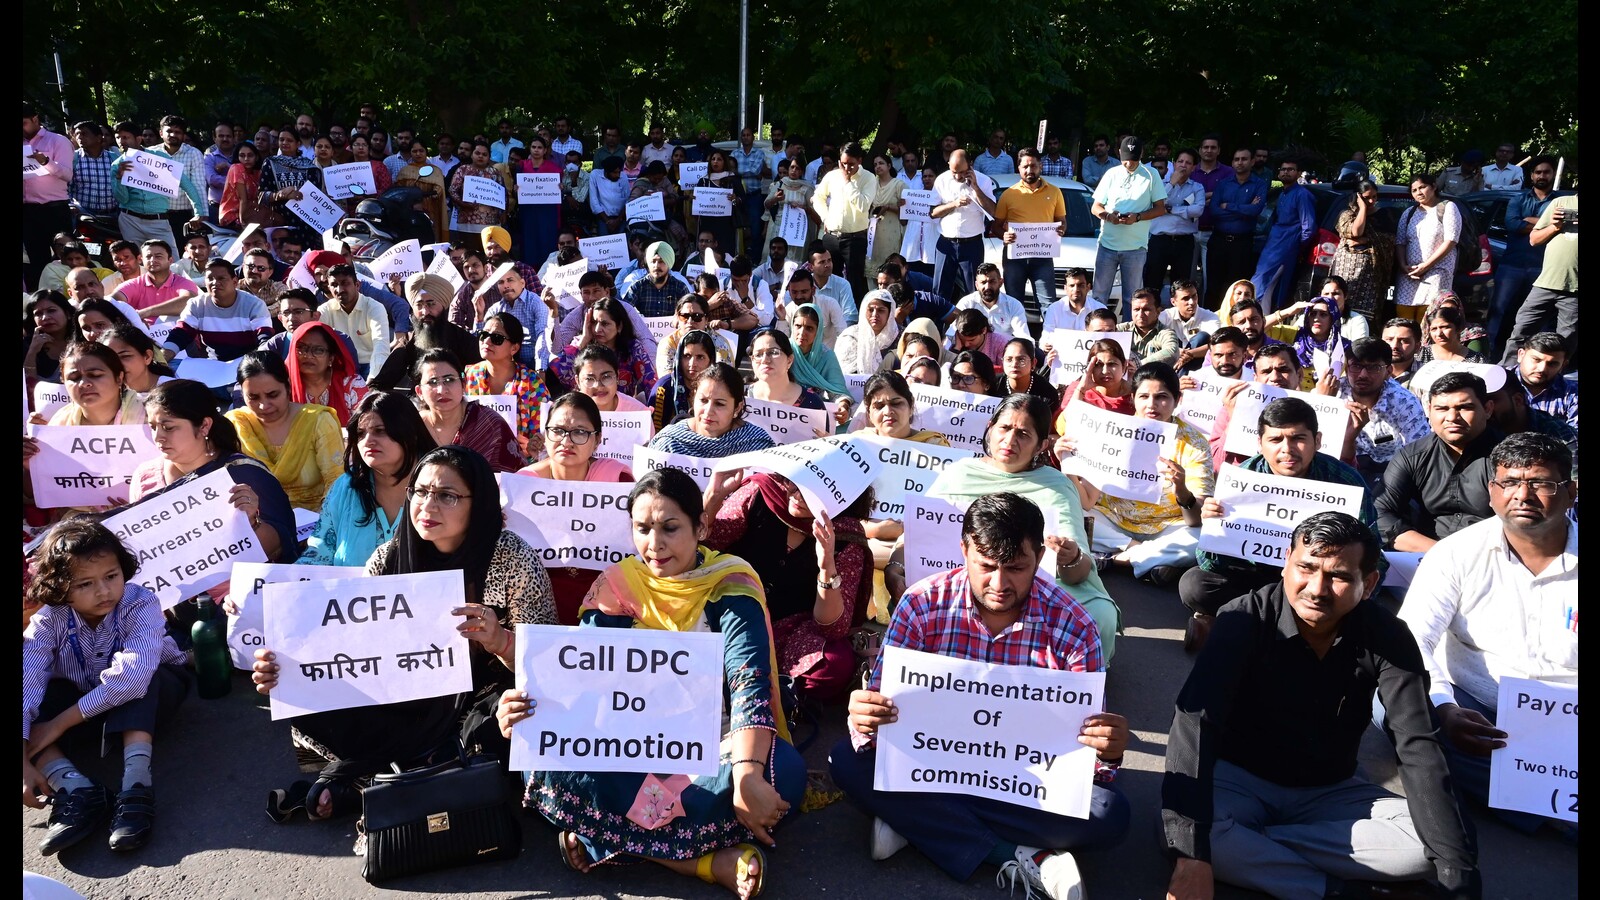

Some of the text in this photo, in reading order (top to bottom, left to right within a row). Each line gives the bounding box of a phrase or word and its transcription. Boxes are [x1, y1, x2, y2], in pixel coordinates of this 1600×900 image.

[136, 155, 174, 172] Call DPC
[327, 165, 370, 175] Implementation
[149, 171, 159, 179] Do
[127, 175, 174, 195] Promotion
[475, 185, 493, 193] Arrears
[309, 190, 336, 215] Call DPC
[480, 195, 504, 205] Teachers
[293, 202, 326, 233] Promotion
[312, 206, 320, 215] Do
[394, 244, 412, 254] DPC
[591, 237, 623, 246] commission
[555, 271, 566, 280] Pay
[1074, 338, 1095, 351] AC
[1200, 381, 1222, 396] Pay
[1247, 389, 1269, 403] Pay
[746, 404, 809, 424] Call DPC
[951, 416, 965, 427] Of
[770, 424, 788, 434] Do
[1080, 412, 1166, 445] Pay fixation
[70, 437, 137, 454] ACFA
[794, 443, 820, 453] For
[1101, 443, 1122, 457] For
[878, 447, 912, 467] Call
[54, 471, 113, 489] फारिग
[804, 460, 847, 505] teacher
[1116, 466, 1161, 482] teacher
[904, 478, 924, 493] Do
[1224, 474, 1347, 506] Pay commission
[172, 494, 202, 515] DA
[202, 486, 220, 501] &
[530, 490, 629, 511] Call DPC
[916, 507, 944, 525] Pay
[1265, 503, 1299, 521] For
[571, 519, 596, 533] Do
[1220, 519, 1241, 530] Two
[138, 517, 224, 565] Arrears to
[170, 536, 252, 582] Teachers
[1252, 542, 1287, 560] 201
[920, 556, 943, 568] Two
[321, 593, 414, 627] ACFA
[300, 643, 454, 682] फारिग करो।
[558, 645, 690, 675] Call DPC
[900, 665, 1093, 706] Implementation
[612, 690, 646, 712] Do
[1517, 692, 1557, 716] Pay
[973, 709, 1003, 727] Of
[538, 730, 704, 761] Promotion
[912, 731, 1057, 771] Seventh Pay
[1514, 758, 1547, 774] Two
[910, 767, 1048, 800] commission
